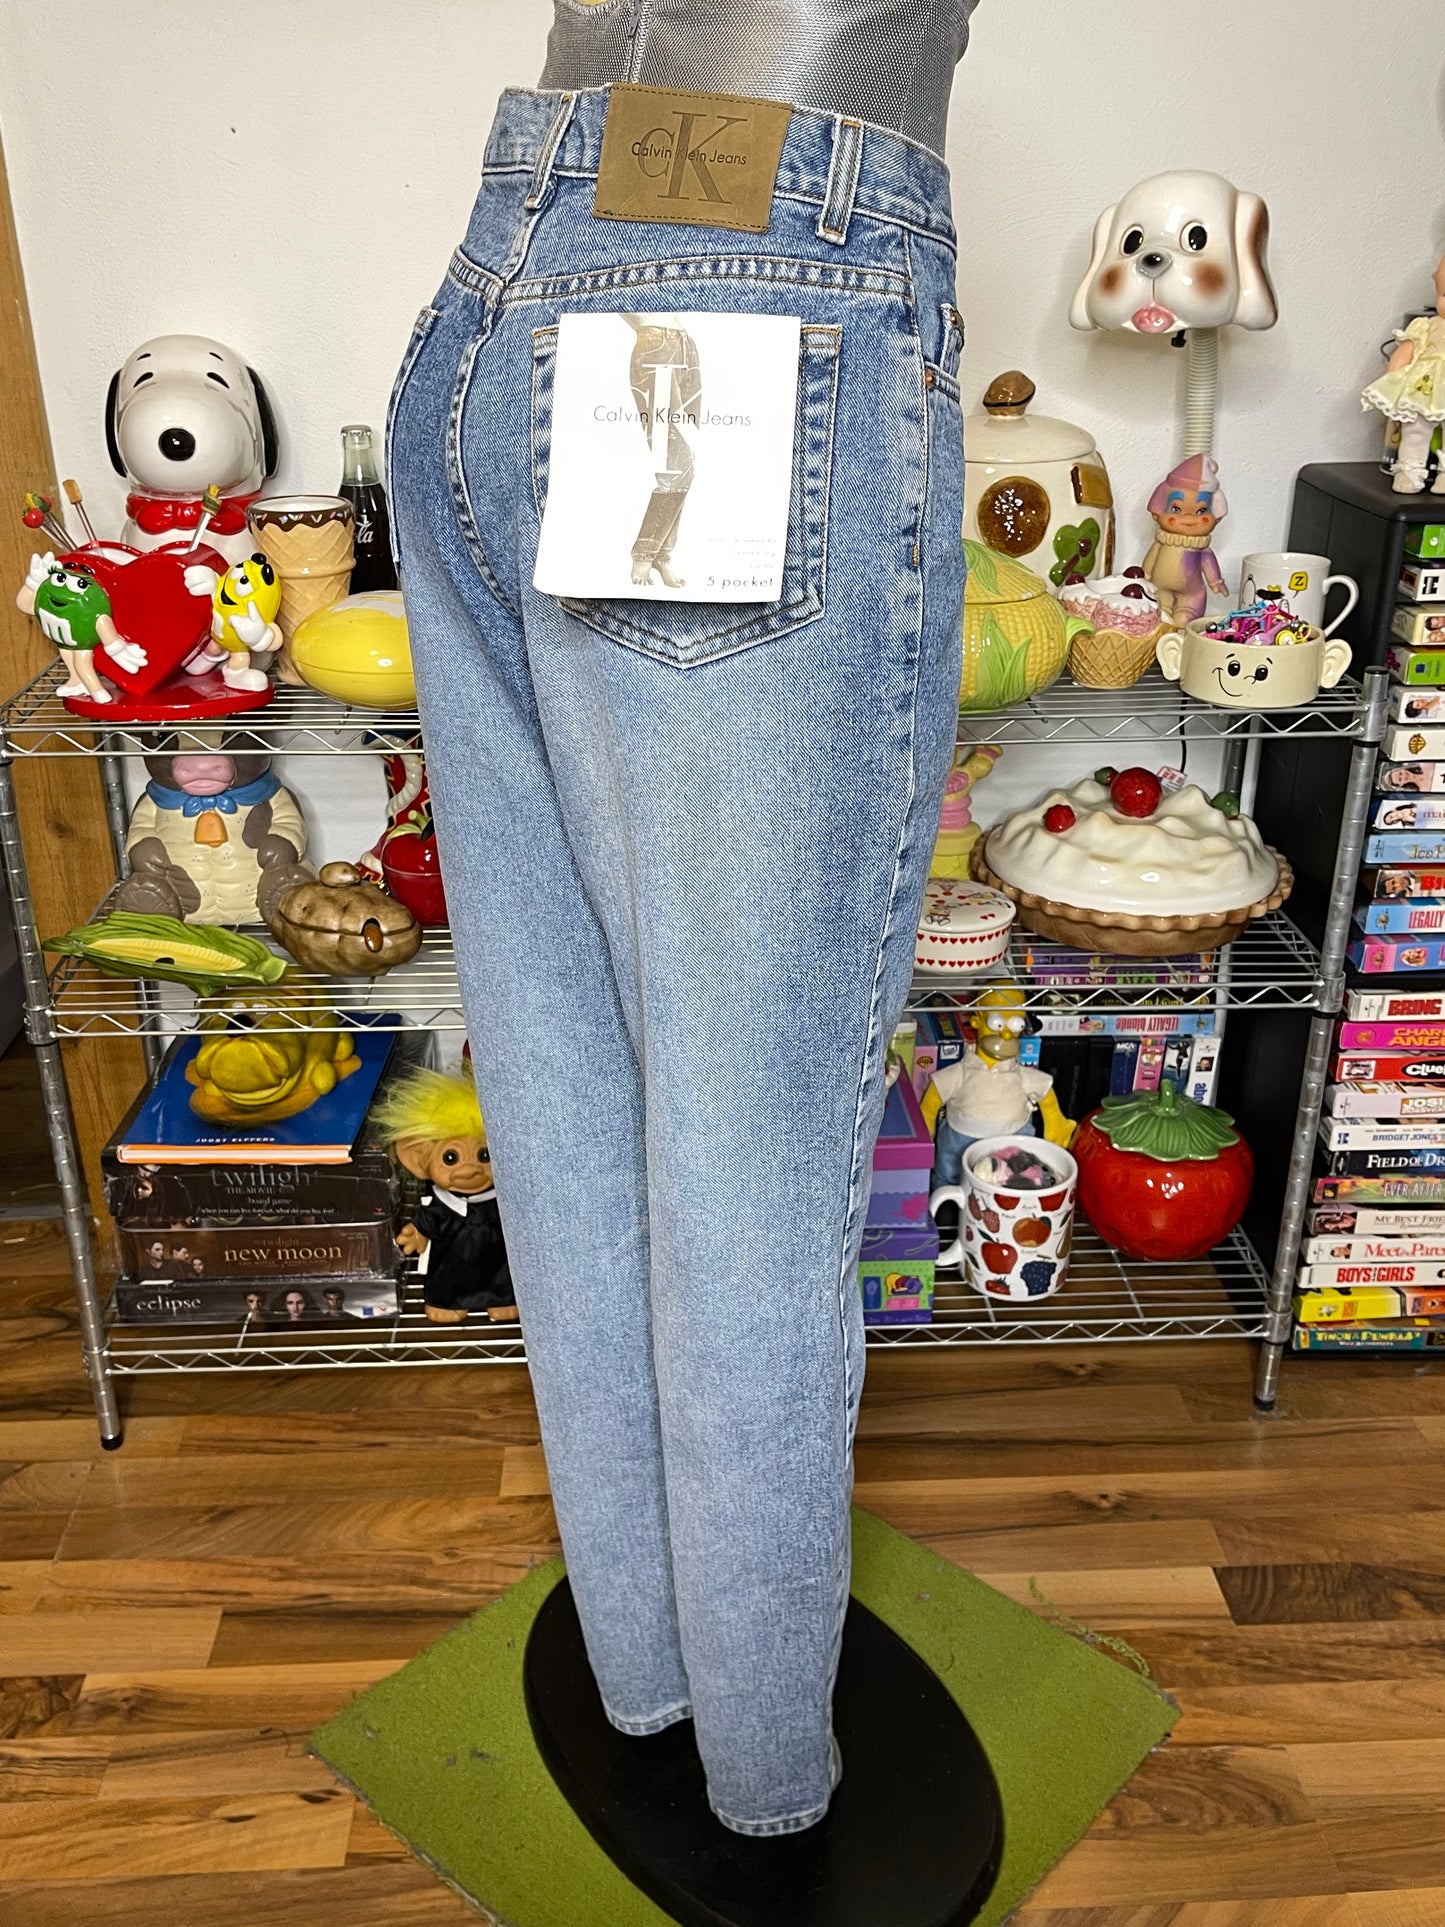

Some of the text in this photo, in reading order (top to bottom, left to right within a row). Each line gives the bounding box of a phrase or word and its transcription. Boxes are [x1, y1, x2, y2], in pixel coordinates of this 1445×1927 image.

[631, 141, 672, 159] Calvin
[709, 149, 747, 165] Jeans
[593, 405, 752, 427] Calvin Klein Jeans
[354, 525, 374, 544] la
[706, 575, 773, 590] 5 pocket
[1294, 575, 1304, 587] Z
[1408, 910, 1445, 929] LEGALLY
[1387, 999, 1443, 1017] BRING
[1147, 1017, 1179, 1033] LEGALLY
[1116, 1042, 1135, 1050] MCA
[1372, 1133, 1410, 1142] BRIDGET
[1365, 1153, 1408, 1169] FIELD
[1375, 1215, 1392, 1223] MY
[1394, 1215, 1420, 1223] BEST
[224, 1245, 343, 1262] new moon
[1336, 1267, 1373, 1283] BOYS
[1376, 1266, 1416, 1282] GIRLS
[136, 1295, 201, 1317] eclipse
